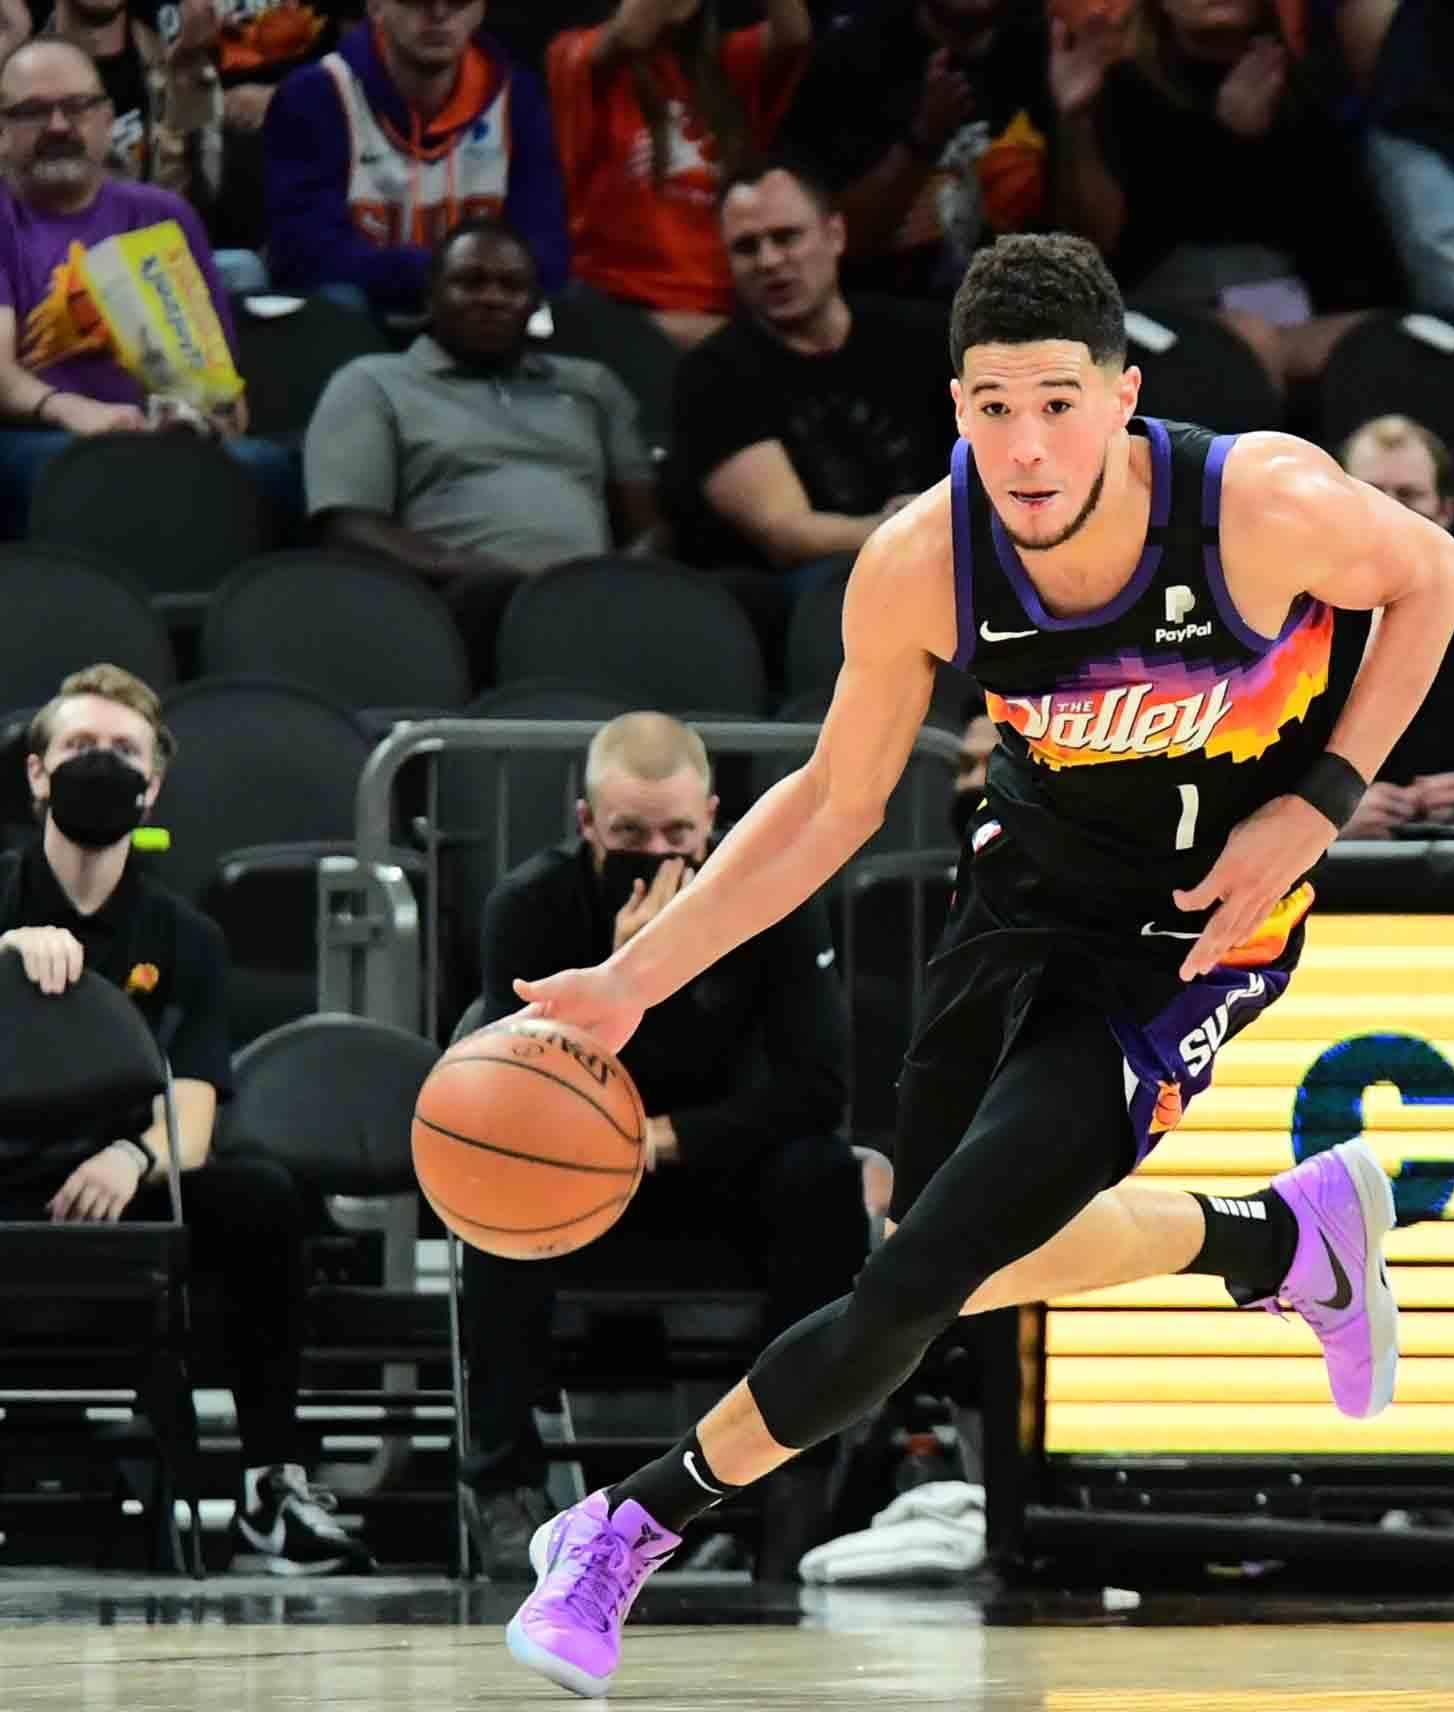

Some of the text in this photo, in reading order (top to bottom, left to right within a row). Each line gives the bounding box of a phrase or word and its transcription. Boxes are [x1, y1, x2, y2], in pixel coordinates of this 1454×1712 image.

[1154, 620, 1212, 643] PayPal
[1005, 679, 1232, 753] Valley
[1056, 700, 1095, 714] THE
[1175, 783, 1200, 850] 1
